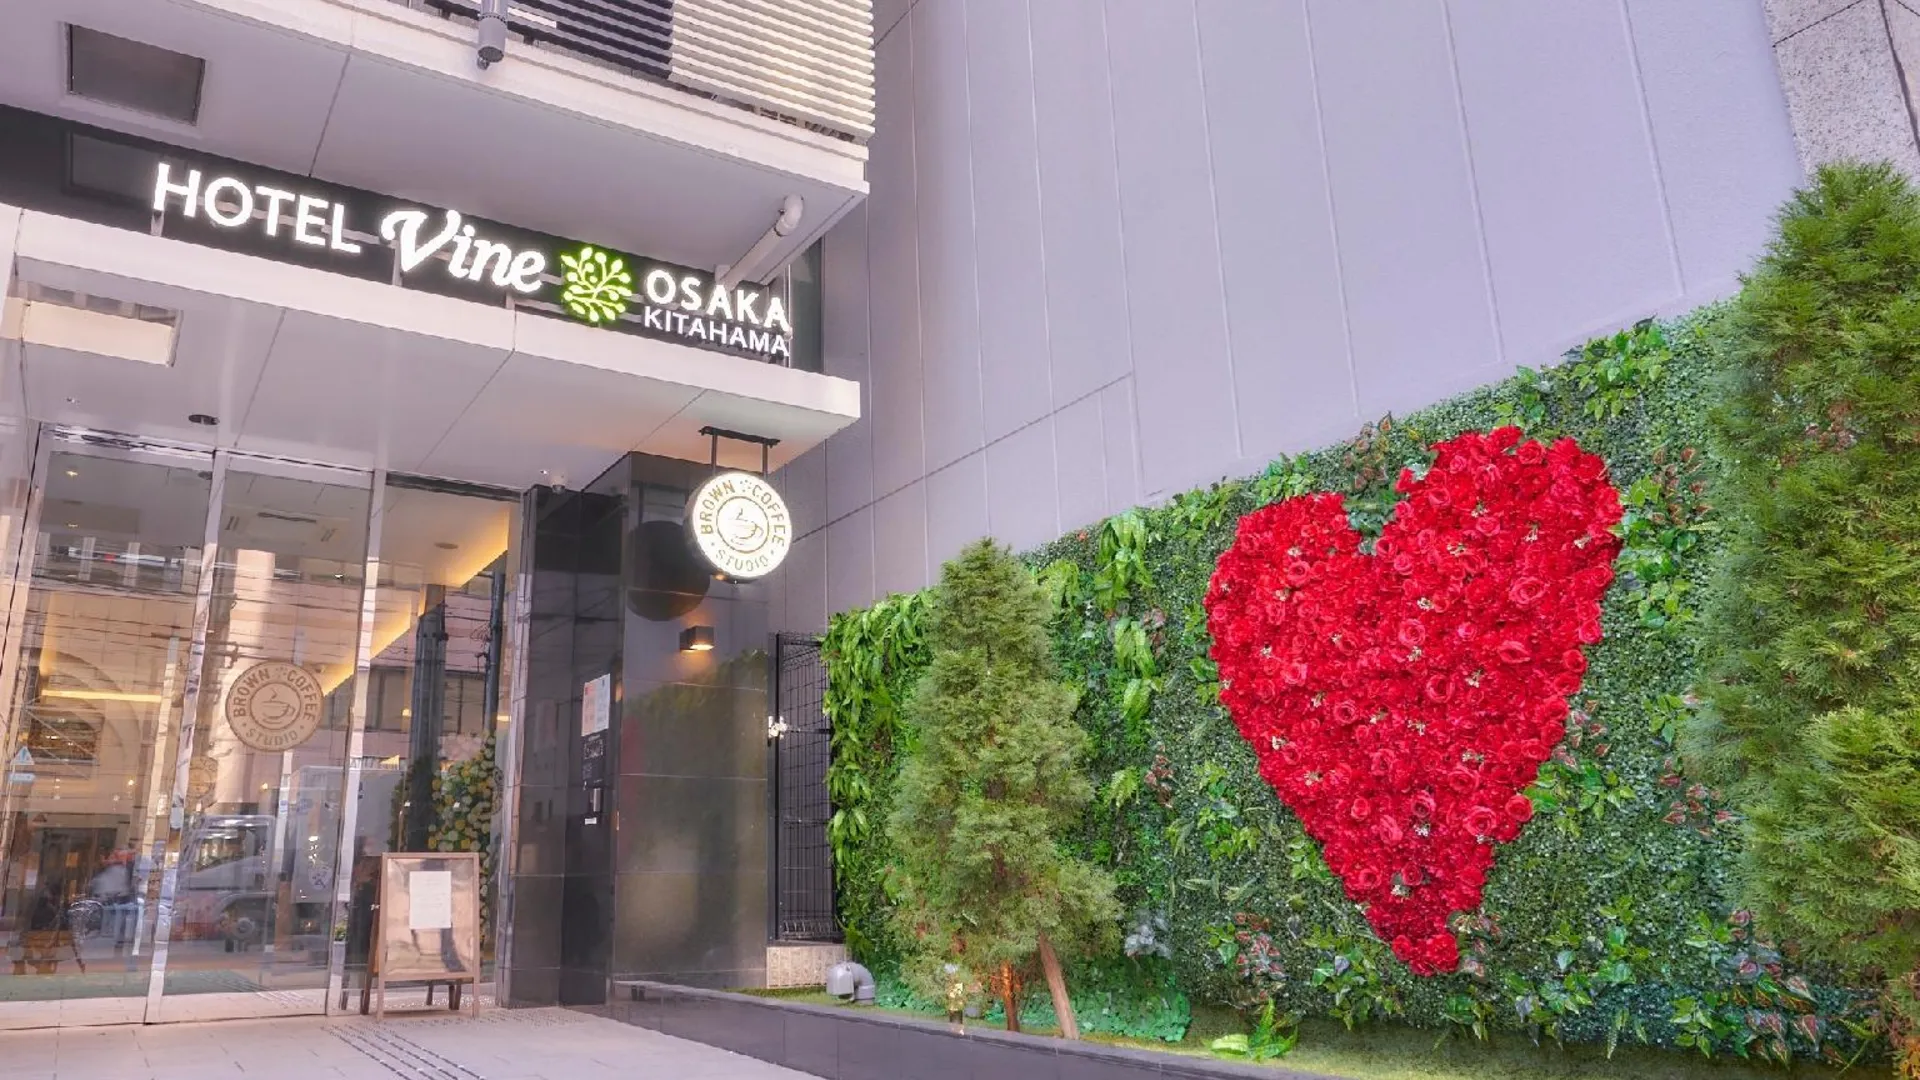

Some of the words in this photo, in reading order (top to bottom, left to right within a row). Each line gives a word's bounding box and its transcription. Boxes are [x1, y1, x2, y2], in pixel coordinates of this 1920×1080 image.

[153, 162, 361, 254] HOTEL
[380, 209, 546, 293] Vine
[646, 269, 793, 332] OSAKA
[644, 306, 790, 357] KITAHAMA
[699, 480, 736, 535] BROWN
[752, 484, 786, 547] COFFEE
[716, 549, 769, 572] STUDIO
[233, 668, 270, 718] BROWN
[286, 670, 318, 721] COFFEE
[246, 728, 299, 746] STUDIO
